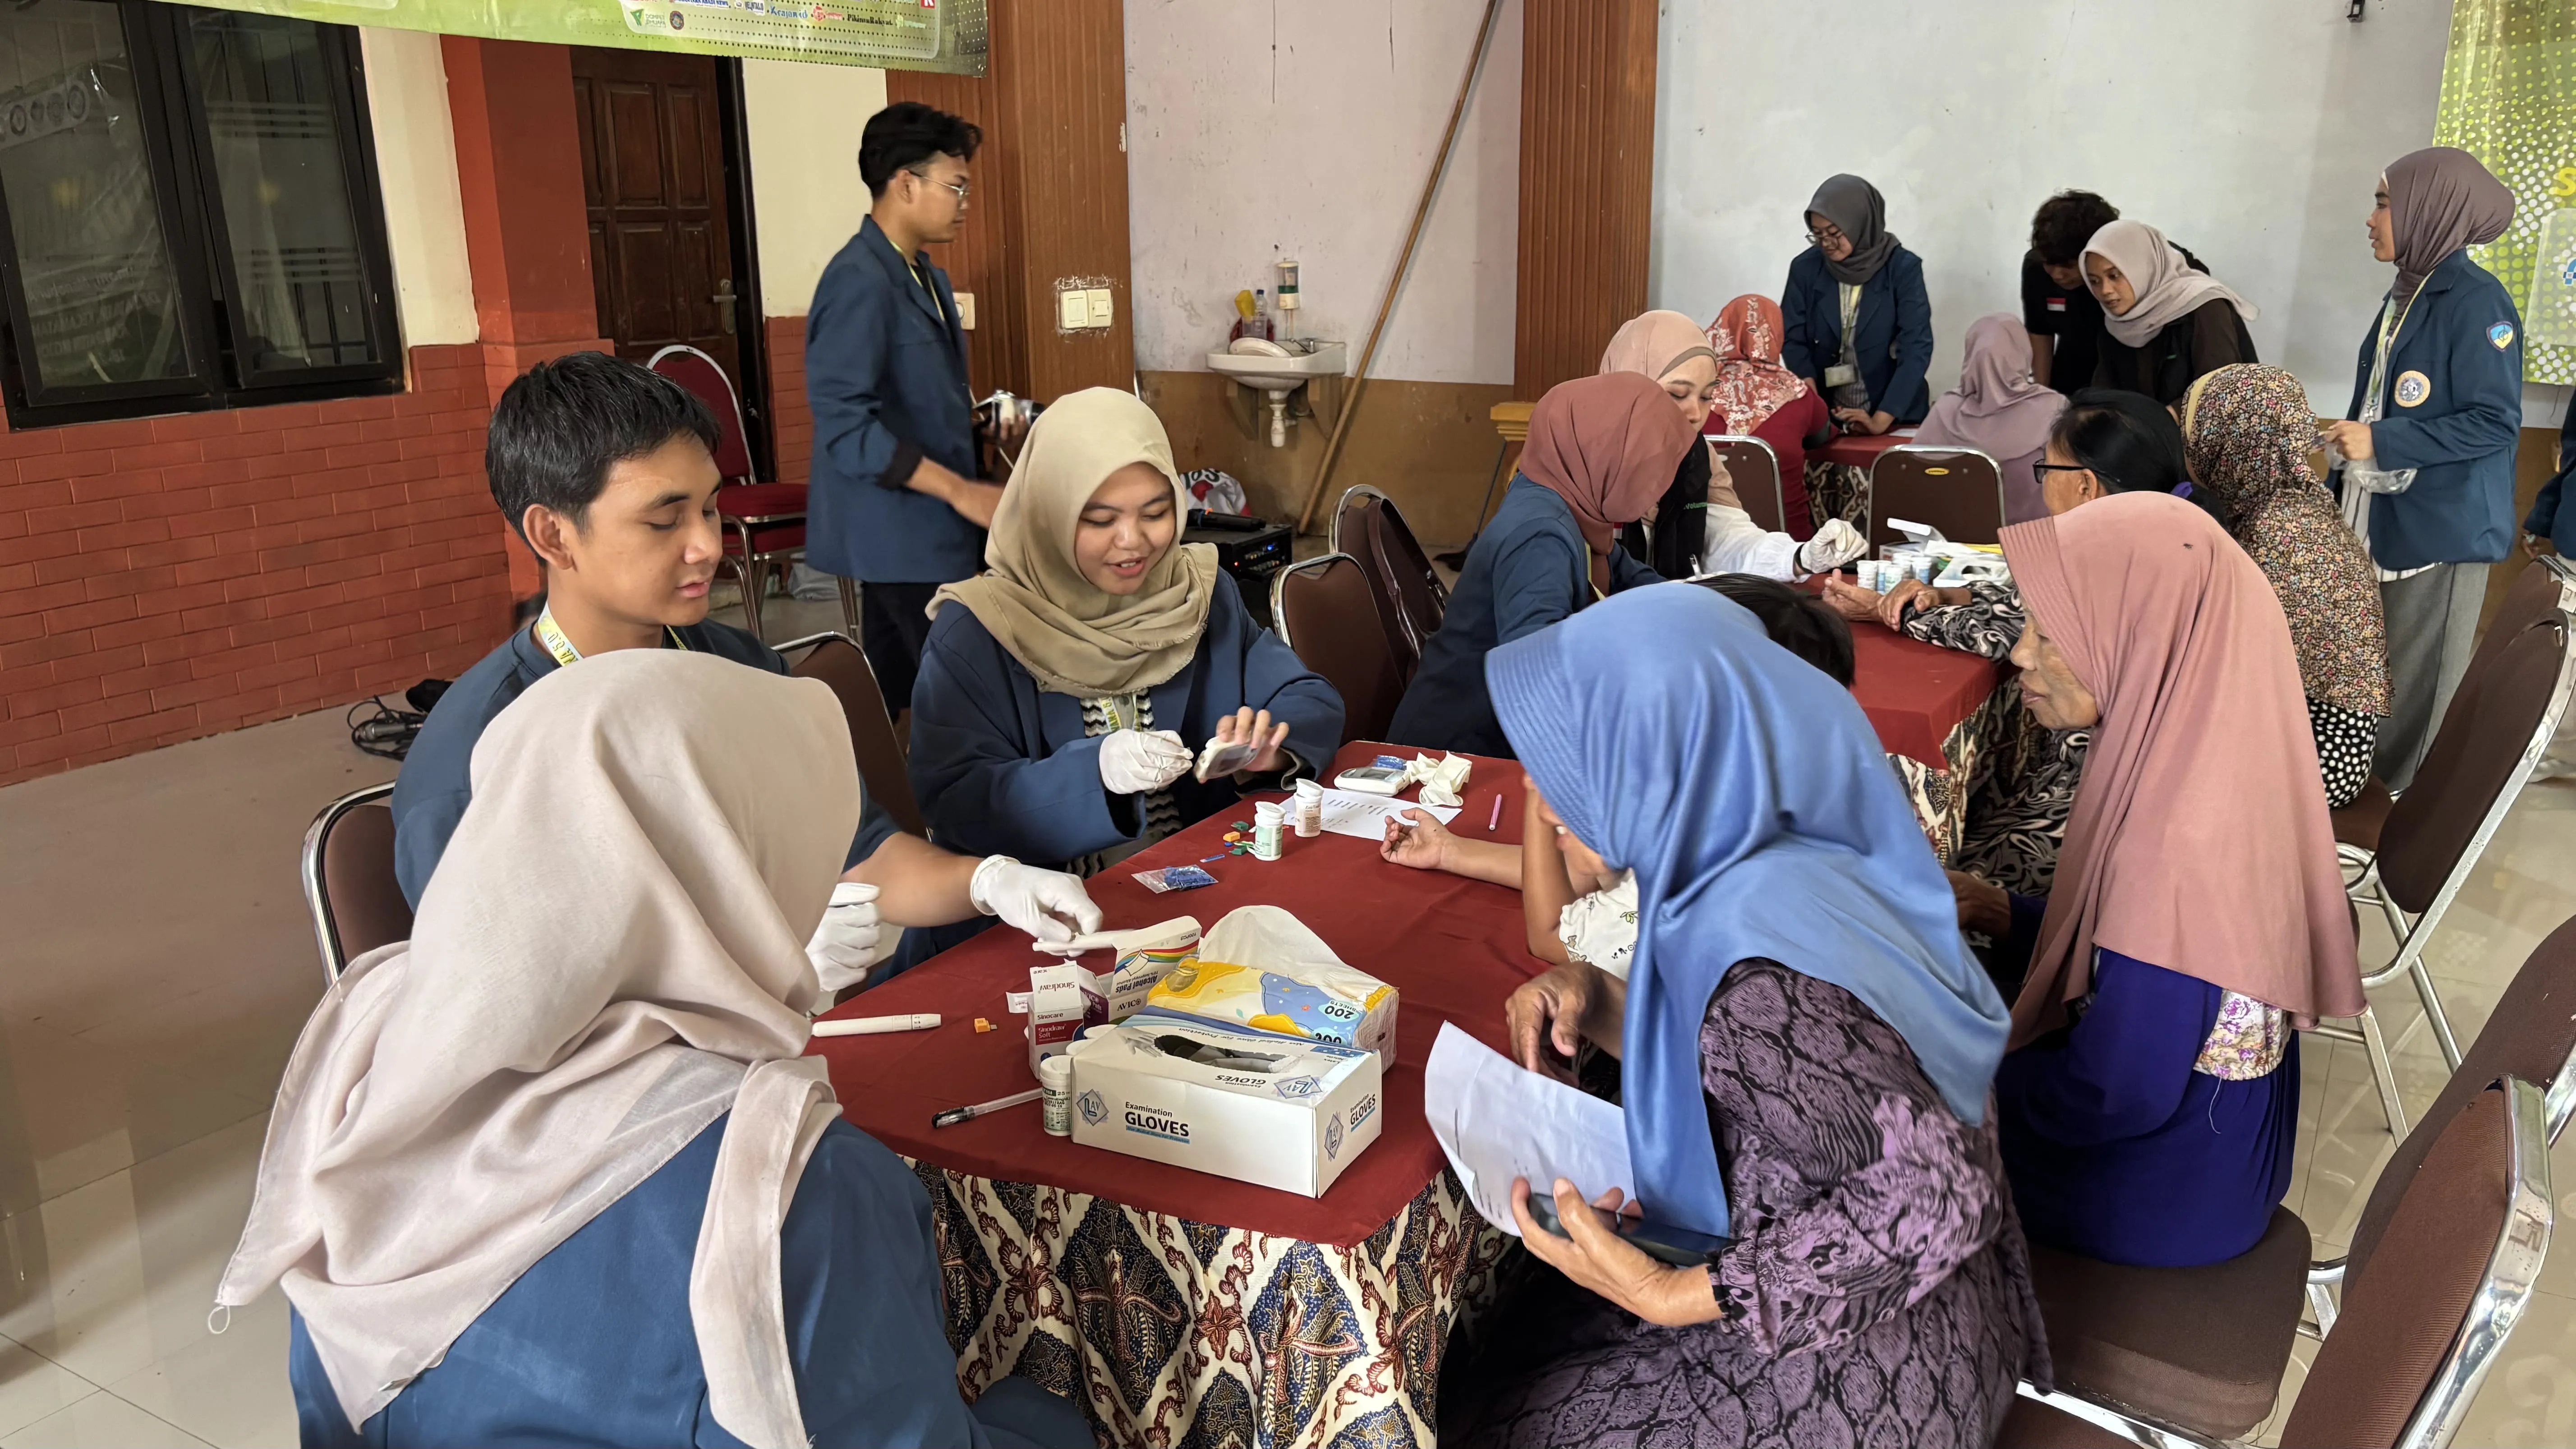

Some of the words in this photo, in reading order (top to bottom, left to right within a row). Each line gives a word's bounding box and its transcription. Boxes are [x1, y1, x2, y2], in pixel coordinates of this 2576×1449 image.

[1040, 982, 1075, 992] Sinodraw
[1115, 983, 1132, 993] Pads
[1133, 975, 1158, 989] Alcohol
[1325, 1005, 1354, 1019] 200
[1330, 1000, 1357, 1012] SHEETS
[1038, 1024, 1065, 1033] Sinodraw
[1178, 1027, 1219, 1039] Protection
[1214, 1075, 1266, 1085] GLOVES
[1126, 1102, 1173, 1118] Examination
[1350, 1094, 1369, 1113] Examination
[1350, 1094, 1375, 1125] GLOVES
[1125, 1111, 1189, 1136] GLOVES
